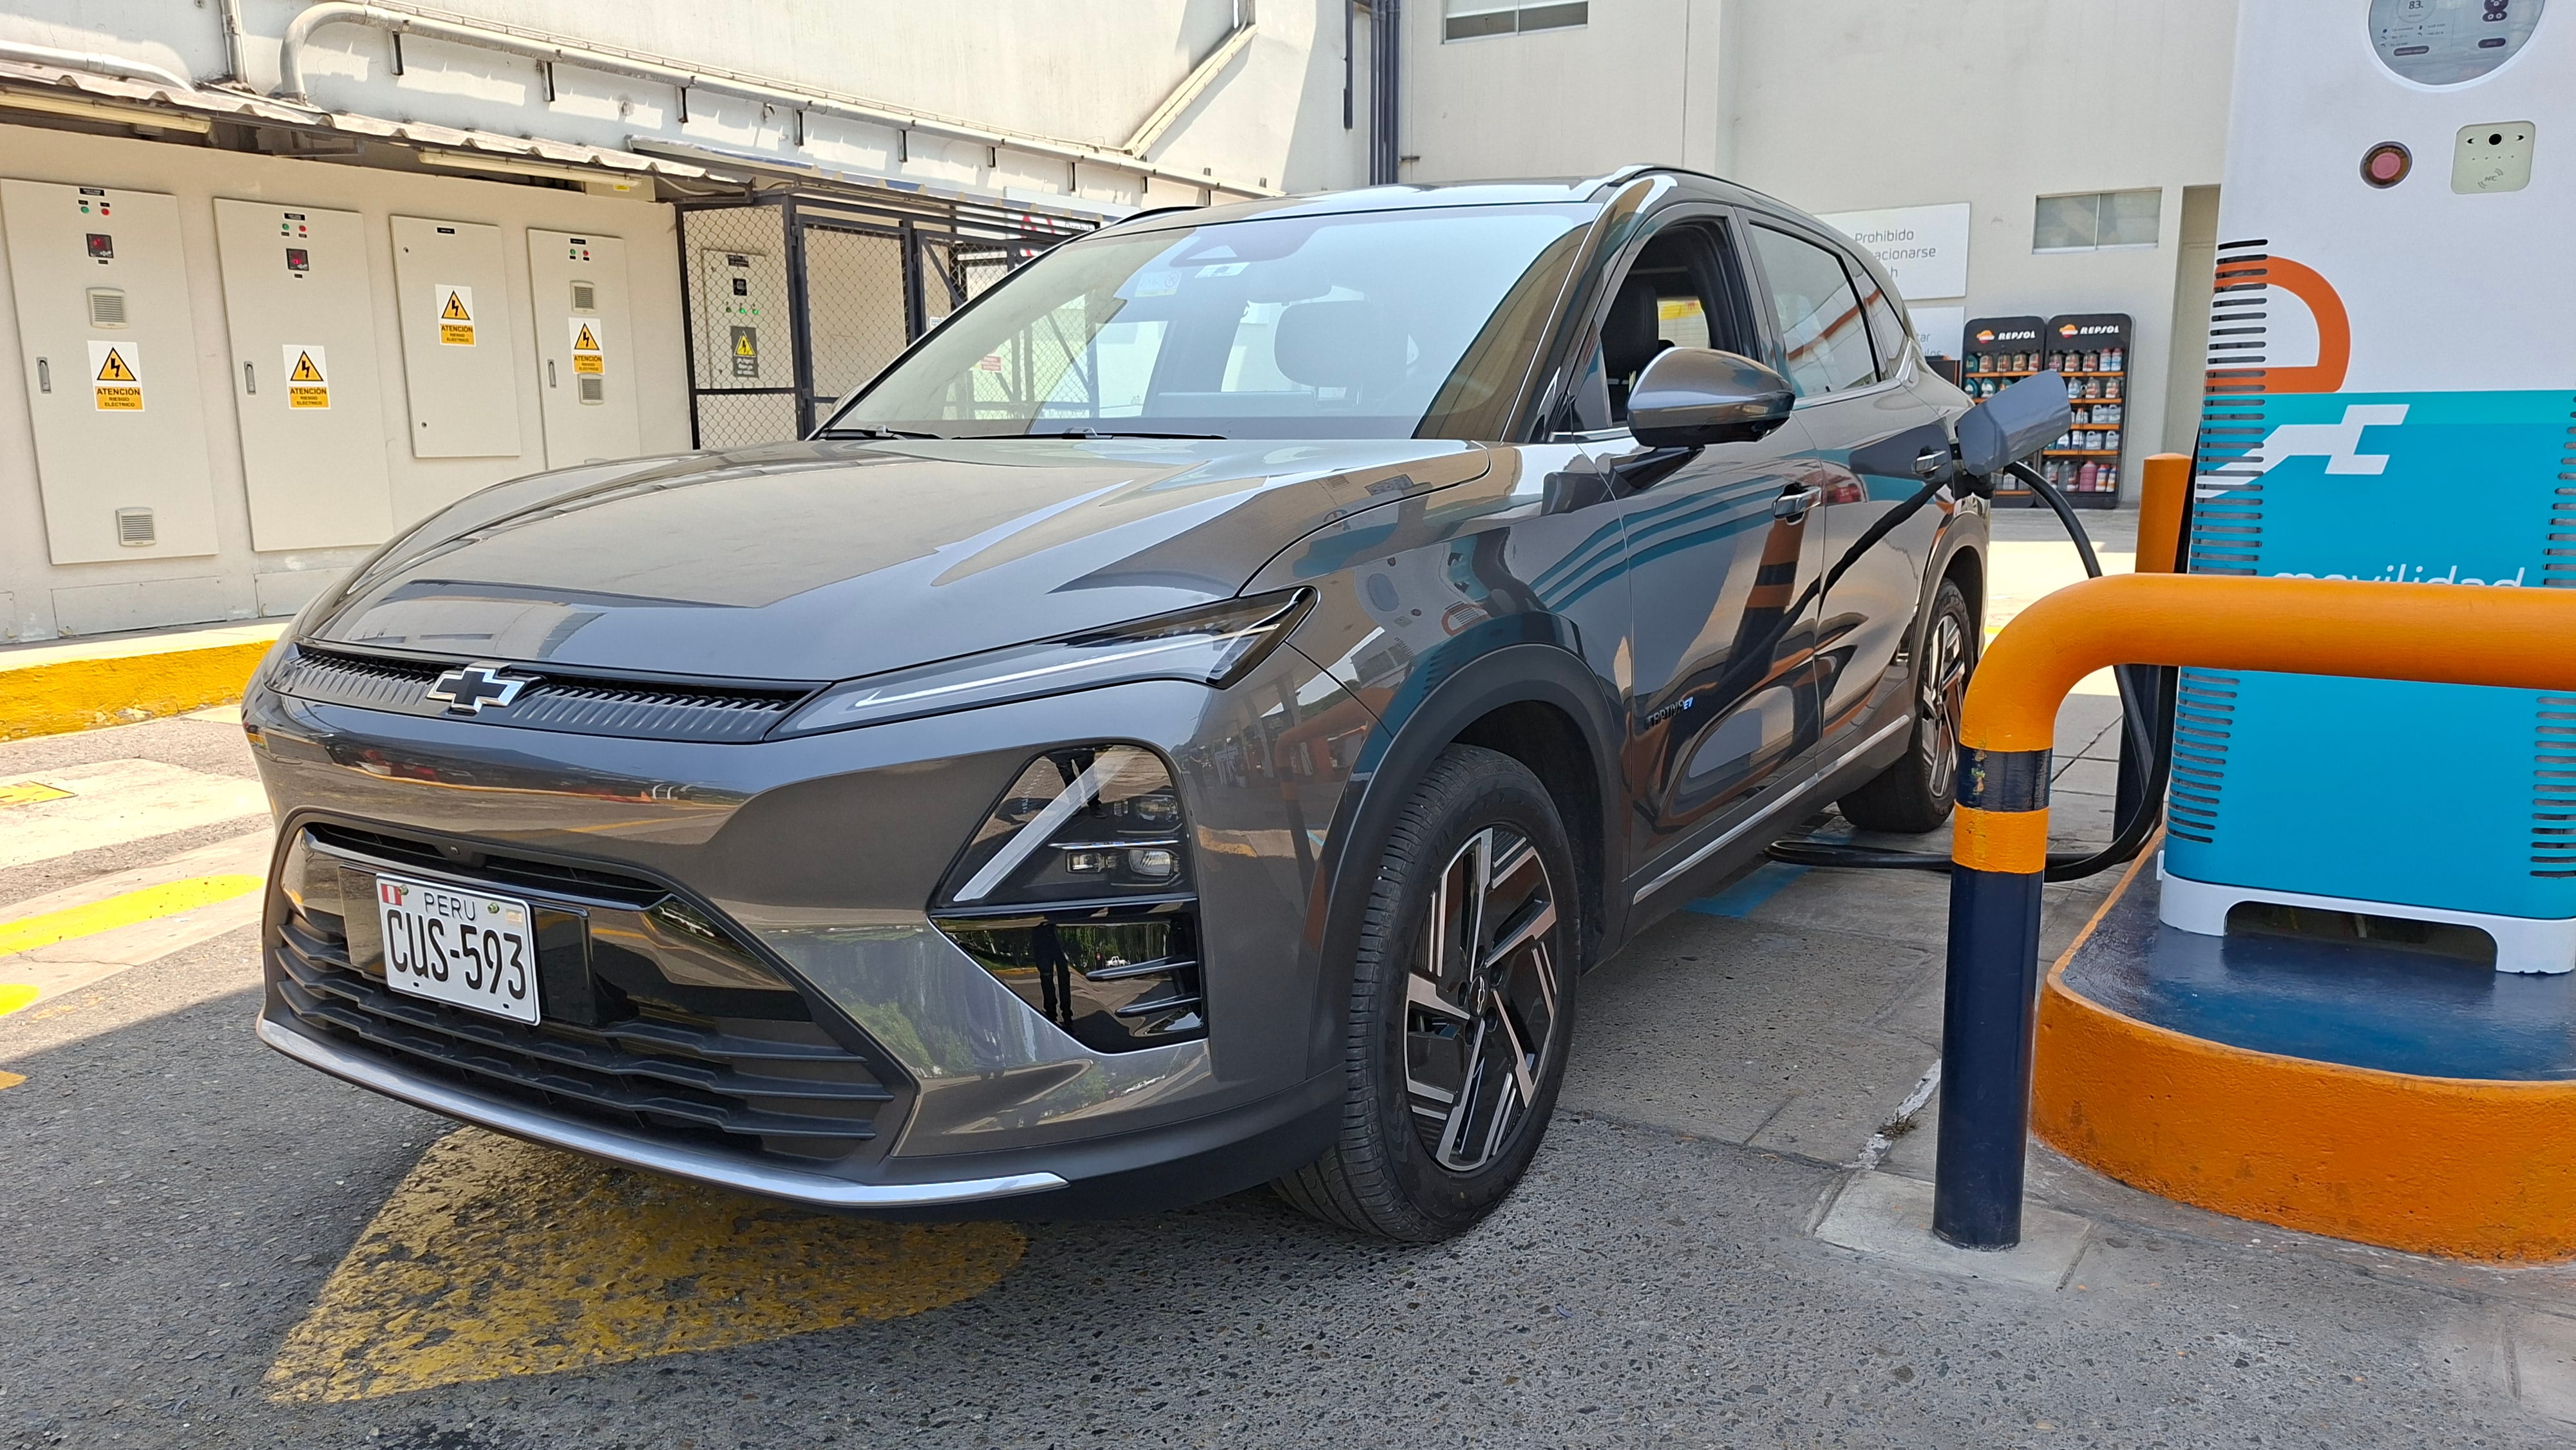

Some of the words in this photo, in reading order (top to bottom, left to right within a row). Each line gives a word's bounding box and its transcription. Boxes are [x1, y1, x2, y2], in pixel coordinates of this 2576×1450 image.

[1855, 228, 1914, 243] Prohibido
[1870, 247, 1937, 261] acionarse
[1998, 330, 2036, 341] REPSOL
[2080, 325, 2119, 335] REPSOL
[424, 892, 476, 921] PERU
[387, 909, 527, 1000] CUS-593
